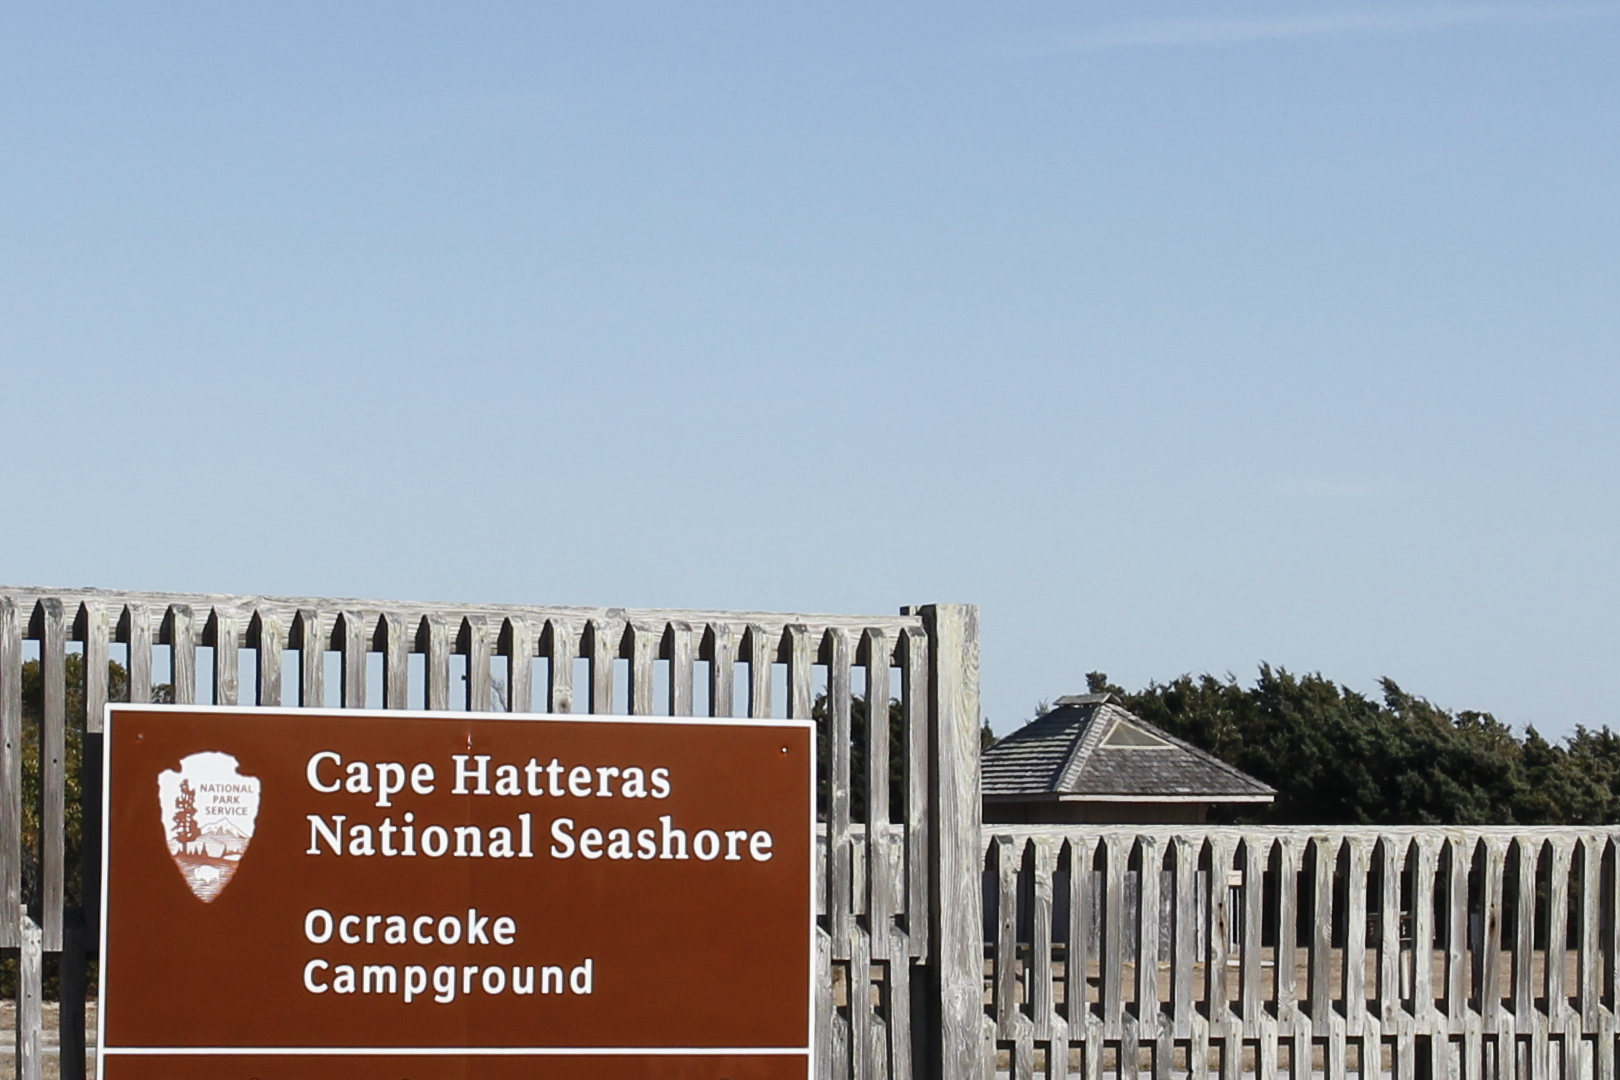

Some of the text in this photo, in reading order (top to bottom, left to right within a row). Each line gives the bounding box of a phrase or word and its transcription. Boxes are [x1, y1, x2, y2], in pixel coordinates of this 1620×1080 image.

[200, 783, 254, 793] NATIONAL
[306, 751, 671, 806] Cape Hatteras
[205, 806, 248, 816] SERVICE
[213, 796, 240, 804] PARK
[306, 812, 773, 862] National Seashore
[304, 908, 516, 945] Ocracoke
[303, 958, 593, 1003] Campground
